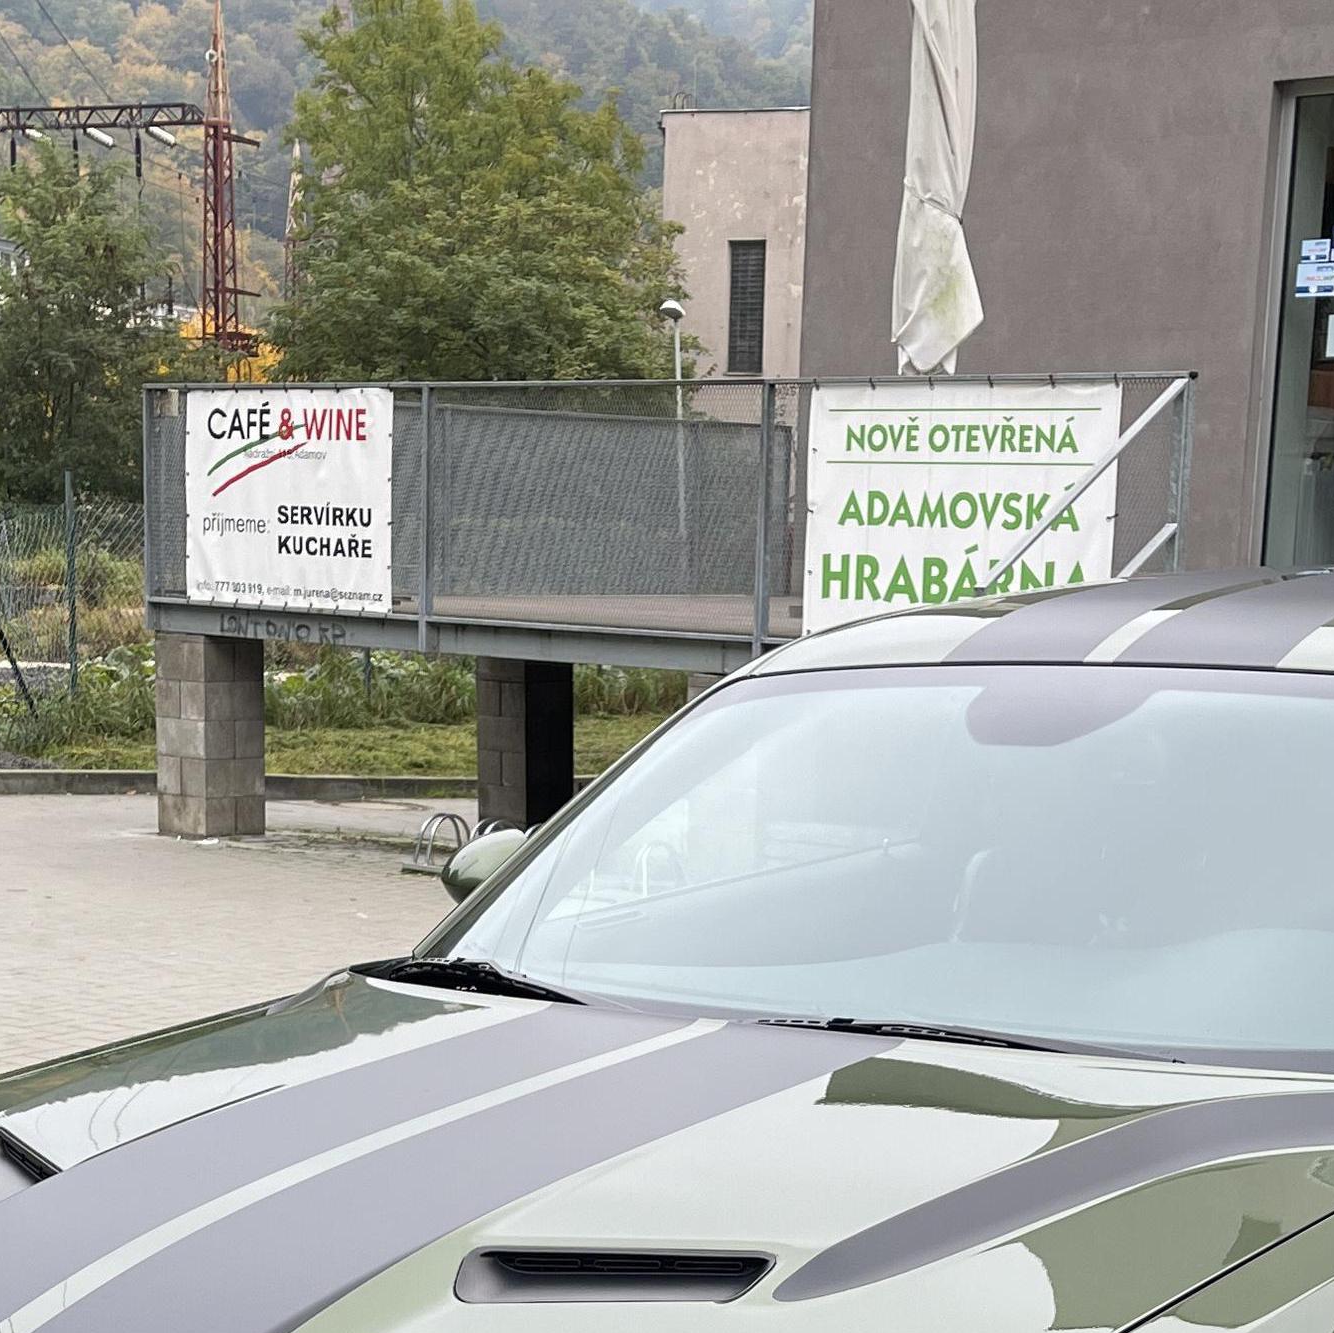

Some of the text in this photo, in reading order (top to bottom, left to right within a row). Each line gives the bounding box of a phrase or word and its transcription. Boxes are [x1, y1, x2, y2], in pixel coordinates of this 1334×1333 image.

[208, 401, 367, 441] CAFÉ & WINE
[846, 416, 1079, 453] NOVĚ OTEVŘENÁ
[202, 502, 373, 537] příjmeme: SERVÍRKU
[838, 482, 1080, 533] ADAMOVSKÁ
[277, 533, 373, 559] KUCHAŘE
